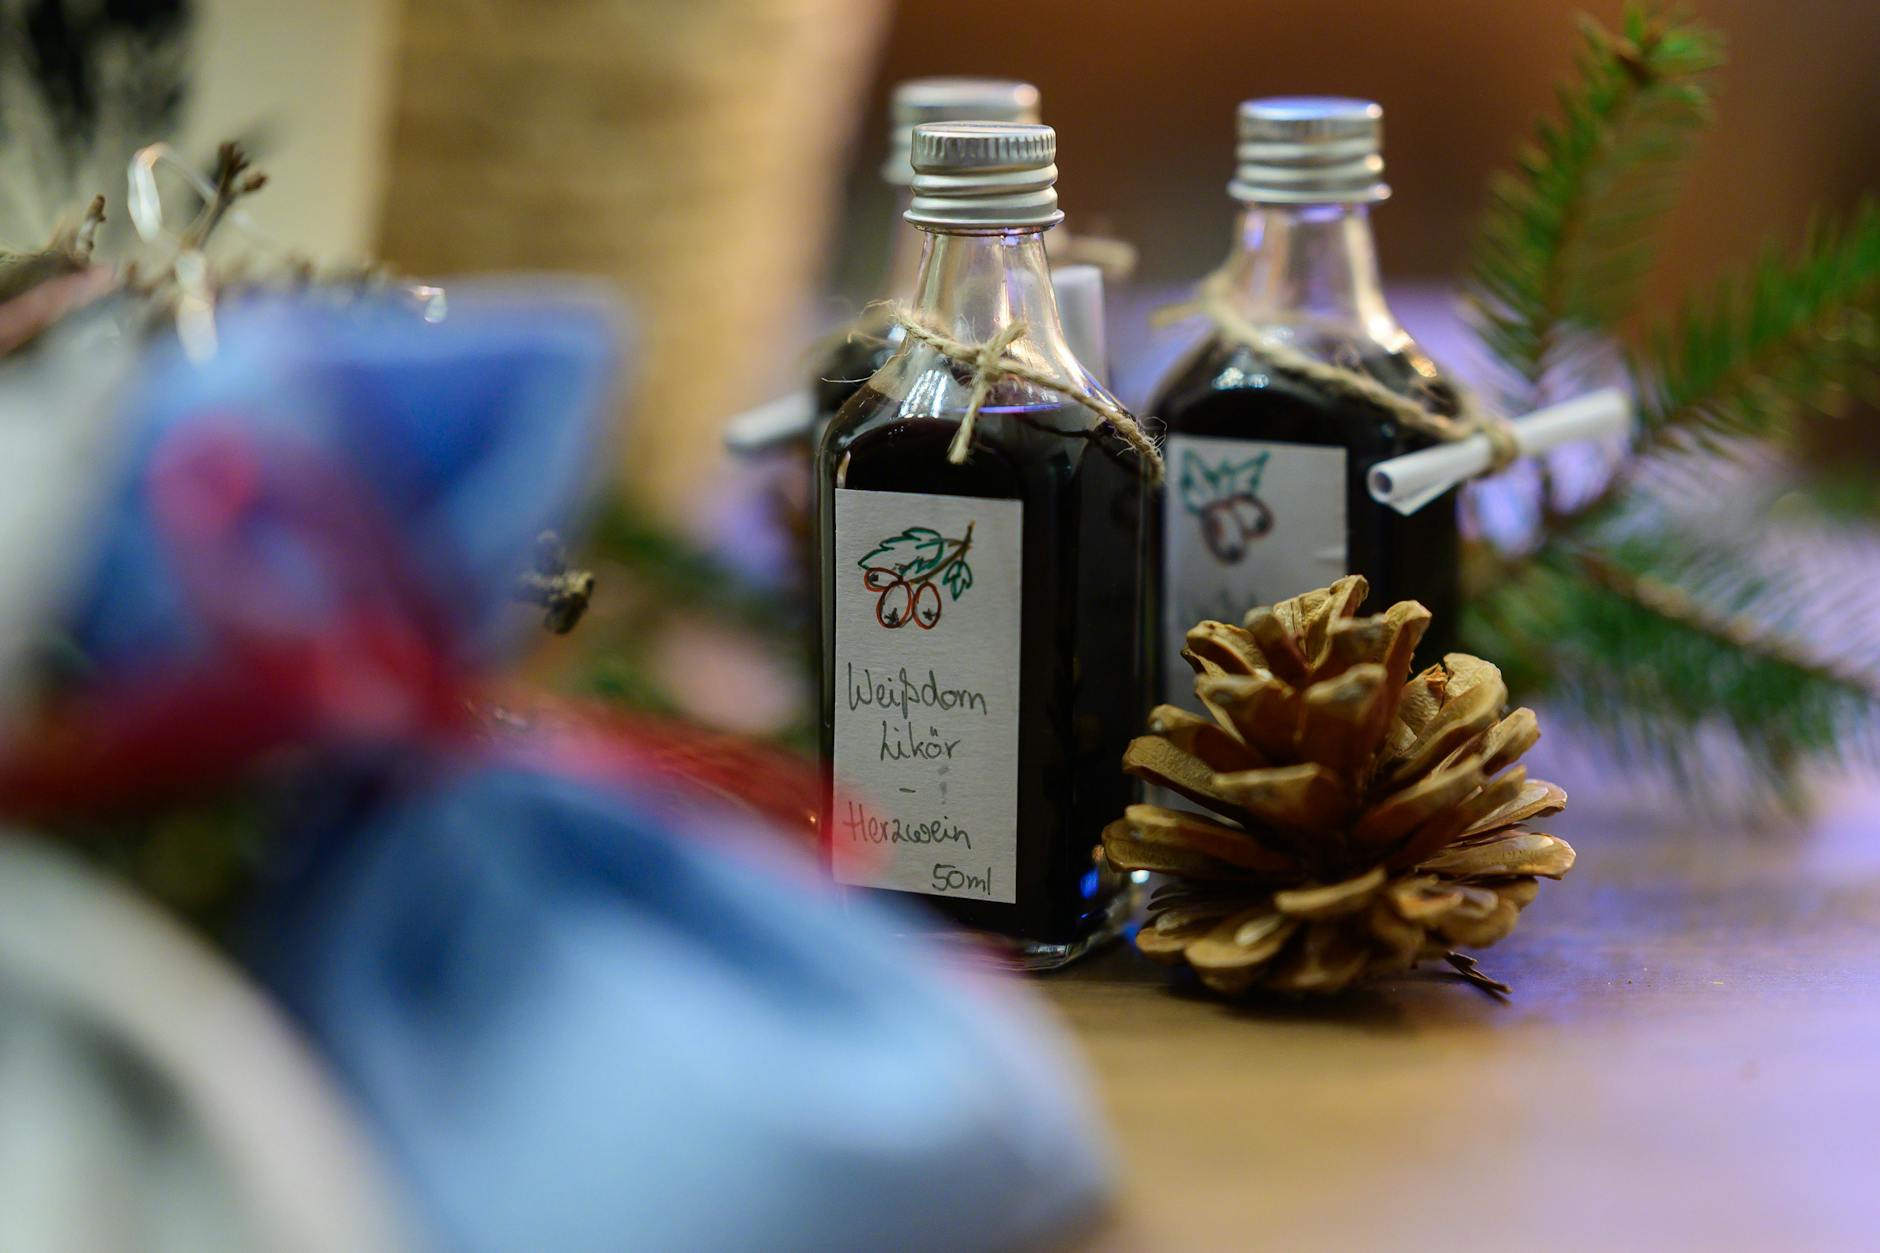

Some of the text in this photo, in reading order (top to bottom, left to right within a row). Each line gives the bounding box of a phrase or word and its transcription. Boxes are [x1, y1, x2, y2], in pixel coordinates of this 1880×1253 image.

[880, 720, 961, 761] Likör
[842, 801, 972, 850] Herzwein
[931, 863, 992, 896] 50ml
